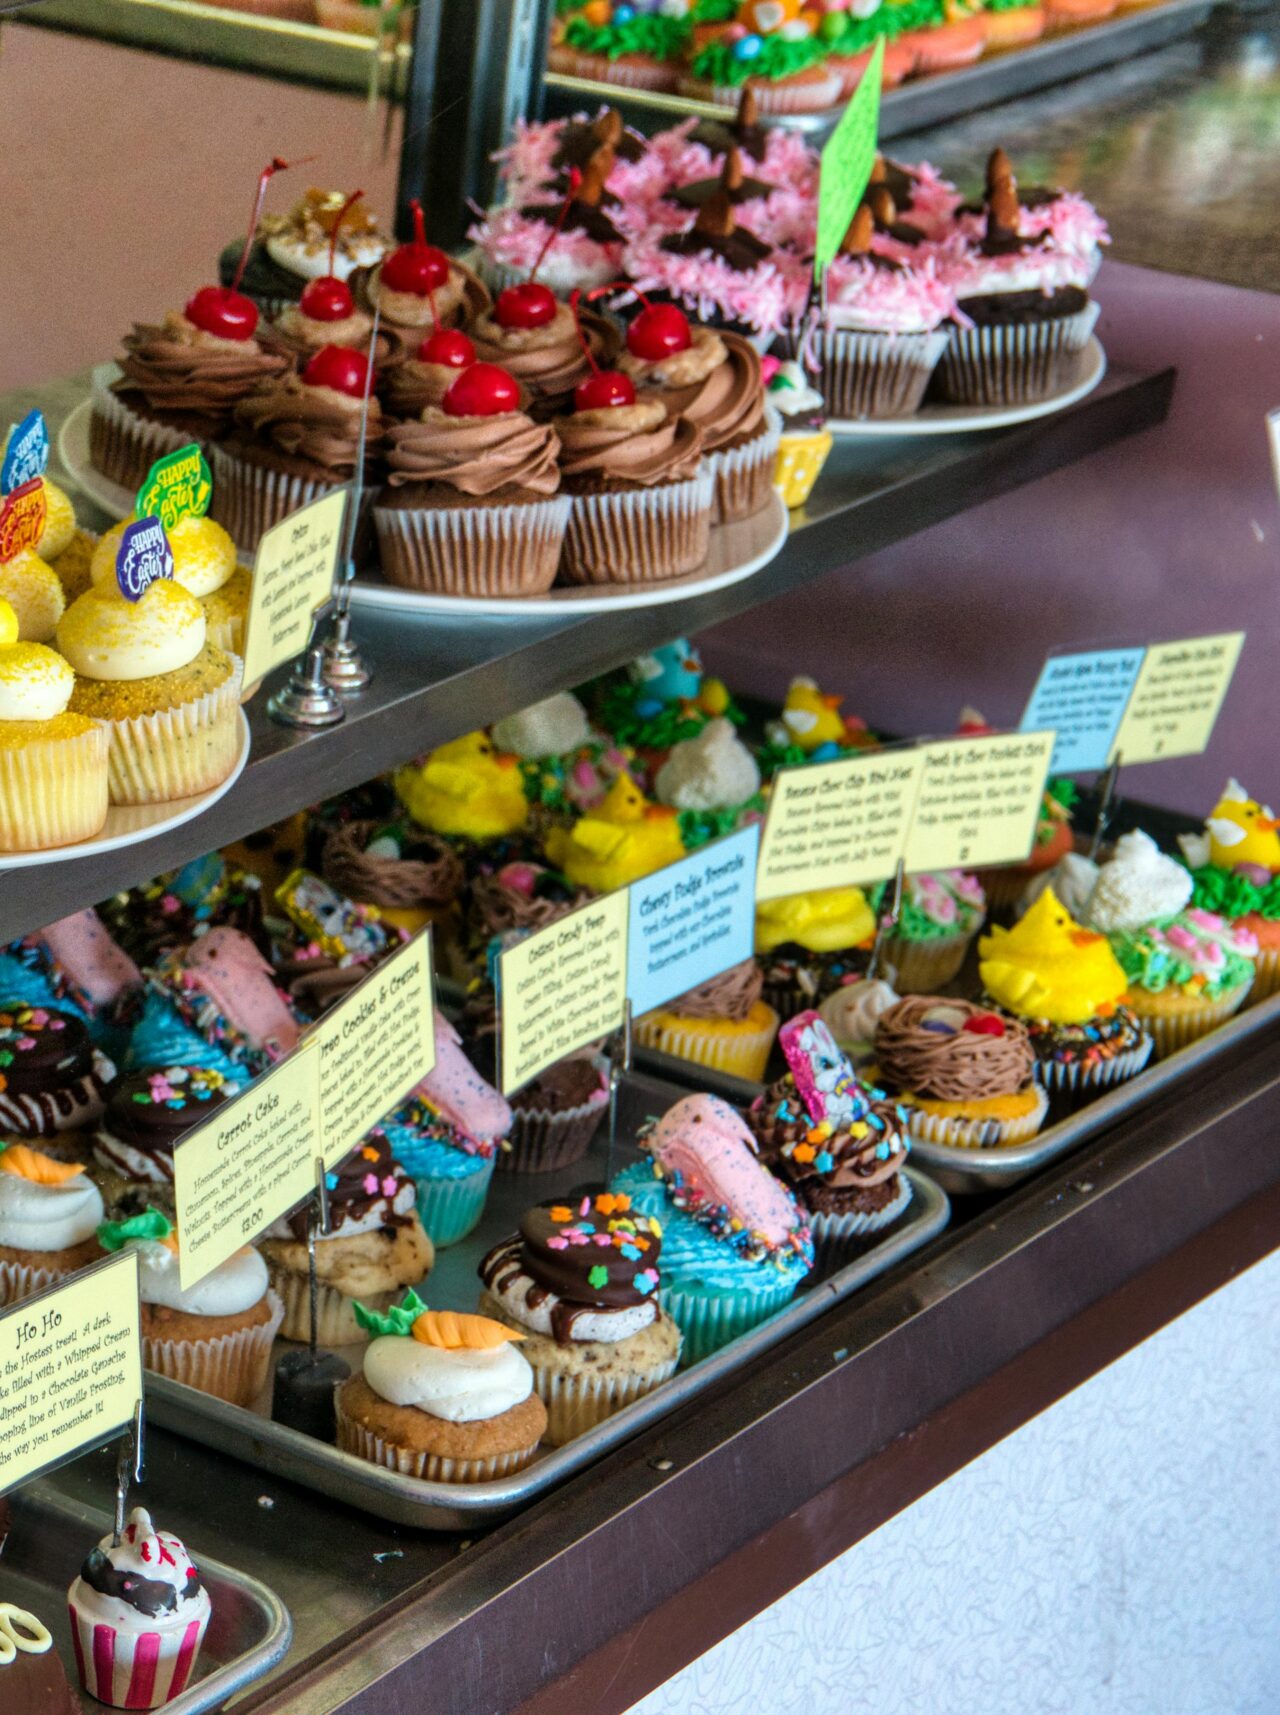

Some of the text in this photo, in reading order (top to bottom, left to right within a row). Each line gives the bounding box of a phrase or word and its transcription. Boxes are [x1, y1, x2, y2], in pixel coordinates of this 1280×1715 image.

[157, 451, 201, 488] HAPPY
[131, 521, 166, 556] HAPPY
[218, 1094, 279, 1150] Carrot Cake
[5, 1361, 18, 1375] the
[21, 1344, 52, 1370] Hostess
[83, 1322, 90, 1336] A
[93, 1312, 111, 1330] dark
[16, 1310, 62, 1350] Ho Ho
[12, 1371, 32, 1392] filled
[36, 1362, 54, 1380] with
[58, 1361, 61, 1370] a
[64, 1337, 101, 1366] Whipped
[104, 1328, 130, 1346] Cream
[0, 1396, 27, 1420] dipped
[30, 1394, 38, 1405] in
[42, 1390, 46, 1399] a
[49, 1369, 88, 1396] Chocolate
[92, 1350, 126, 1375] Ganache
[29, 1413, 44, 1428] line
[48, 1402, 56, 1417] of
[60, 1389, 87, 1410] Vanilla
[14, 1441, 30, 1456] way
[33, 1433, 48, 1450] you
[52, 1409, 92, 1438] remember
